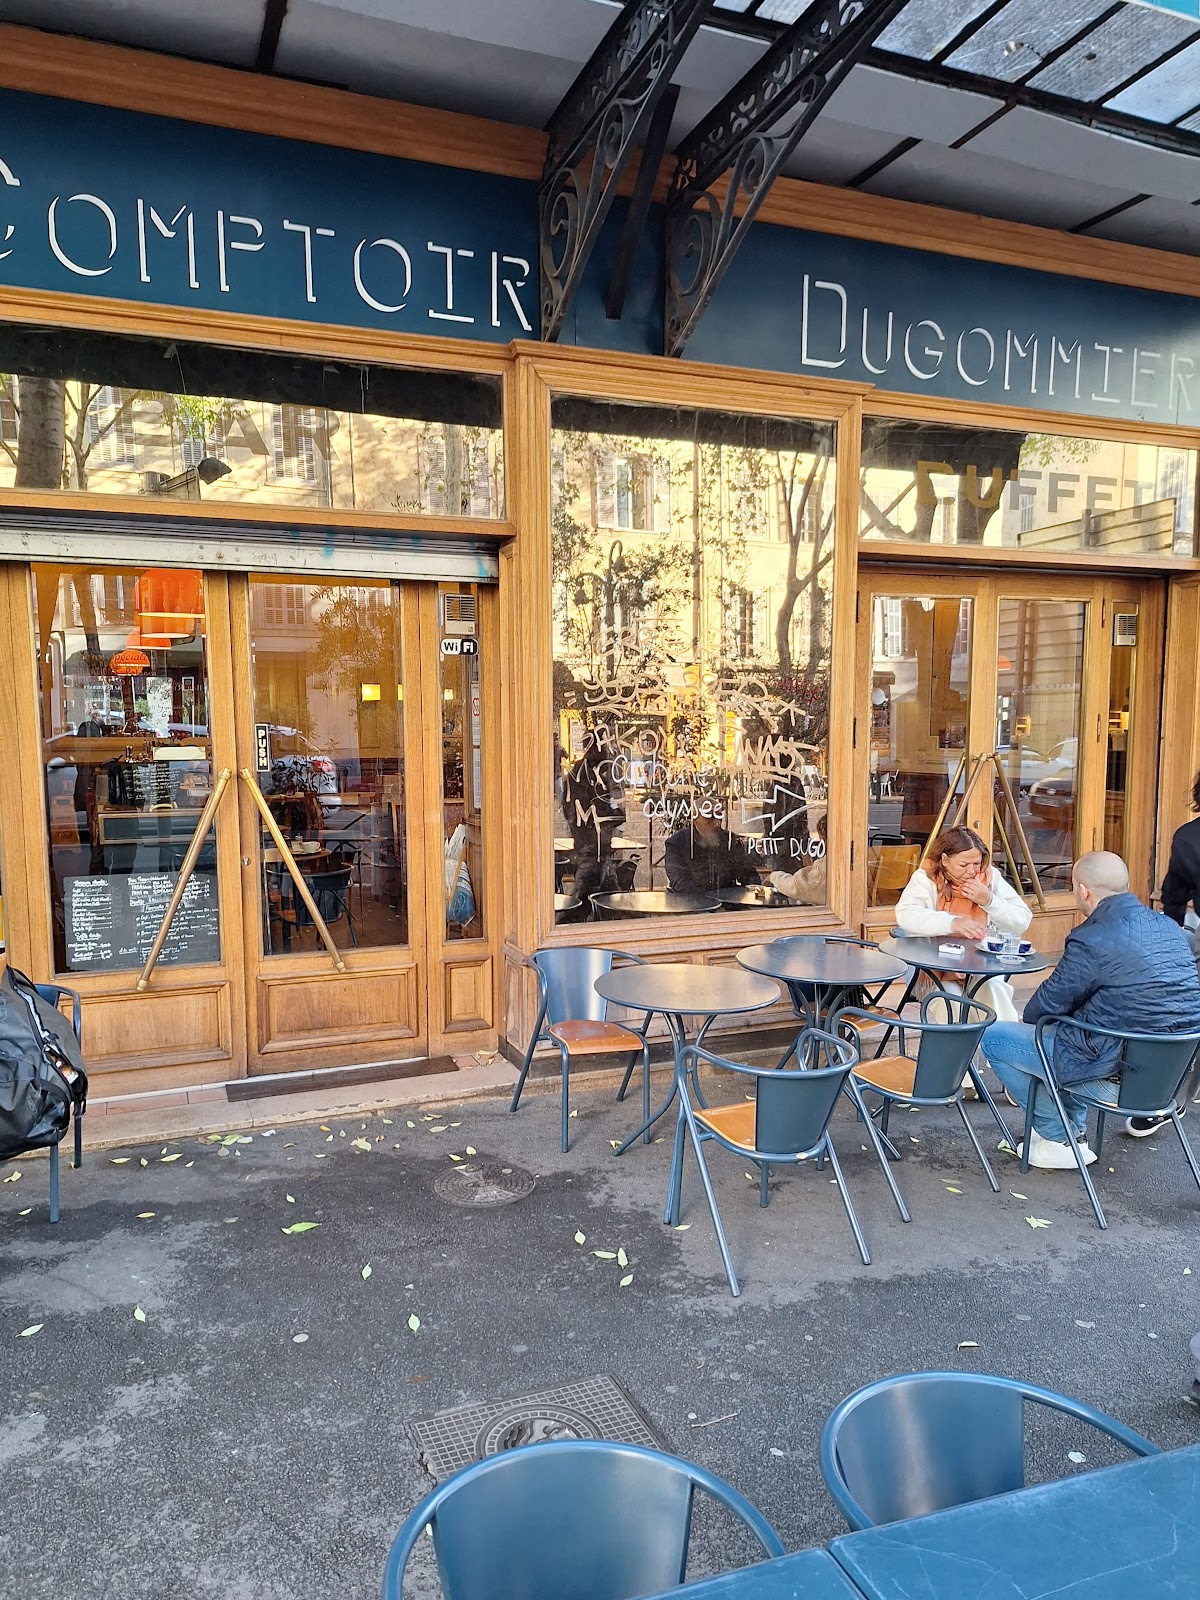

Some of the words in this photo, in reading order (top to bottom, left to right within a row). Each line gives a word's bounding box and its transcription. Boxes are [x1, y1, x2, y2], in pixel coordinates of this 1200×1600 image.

[801, 273, 1195, 410] DUGOMMIER
[122, 390, 341, 461] BAR
[915, 460, 1153, 519] BUFFET
[258, 729, 267, 767] PUSH
[747, 832, 785, 855] PETIT
[789, 838, 826, 861] DUGO
